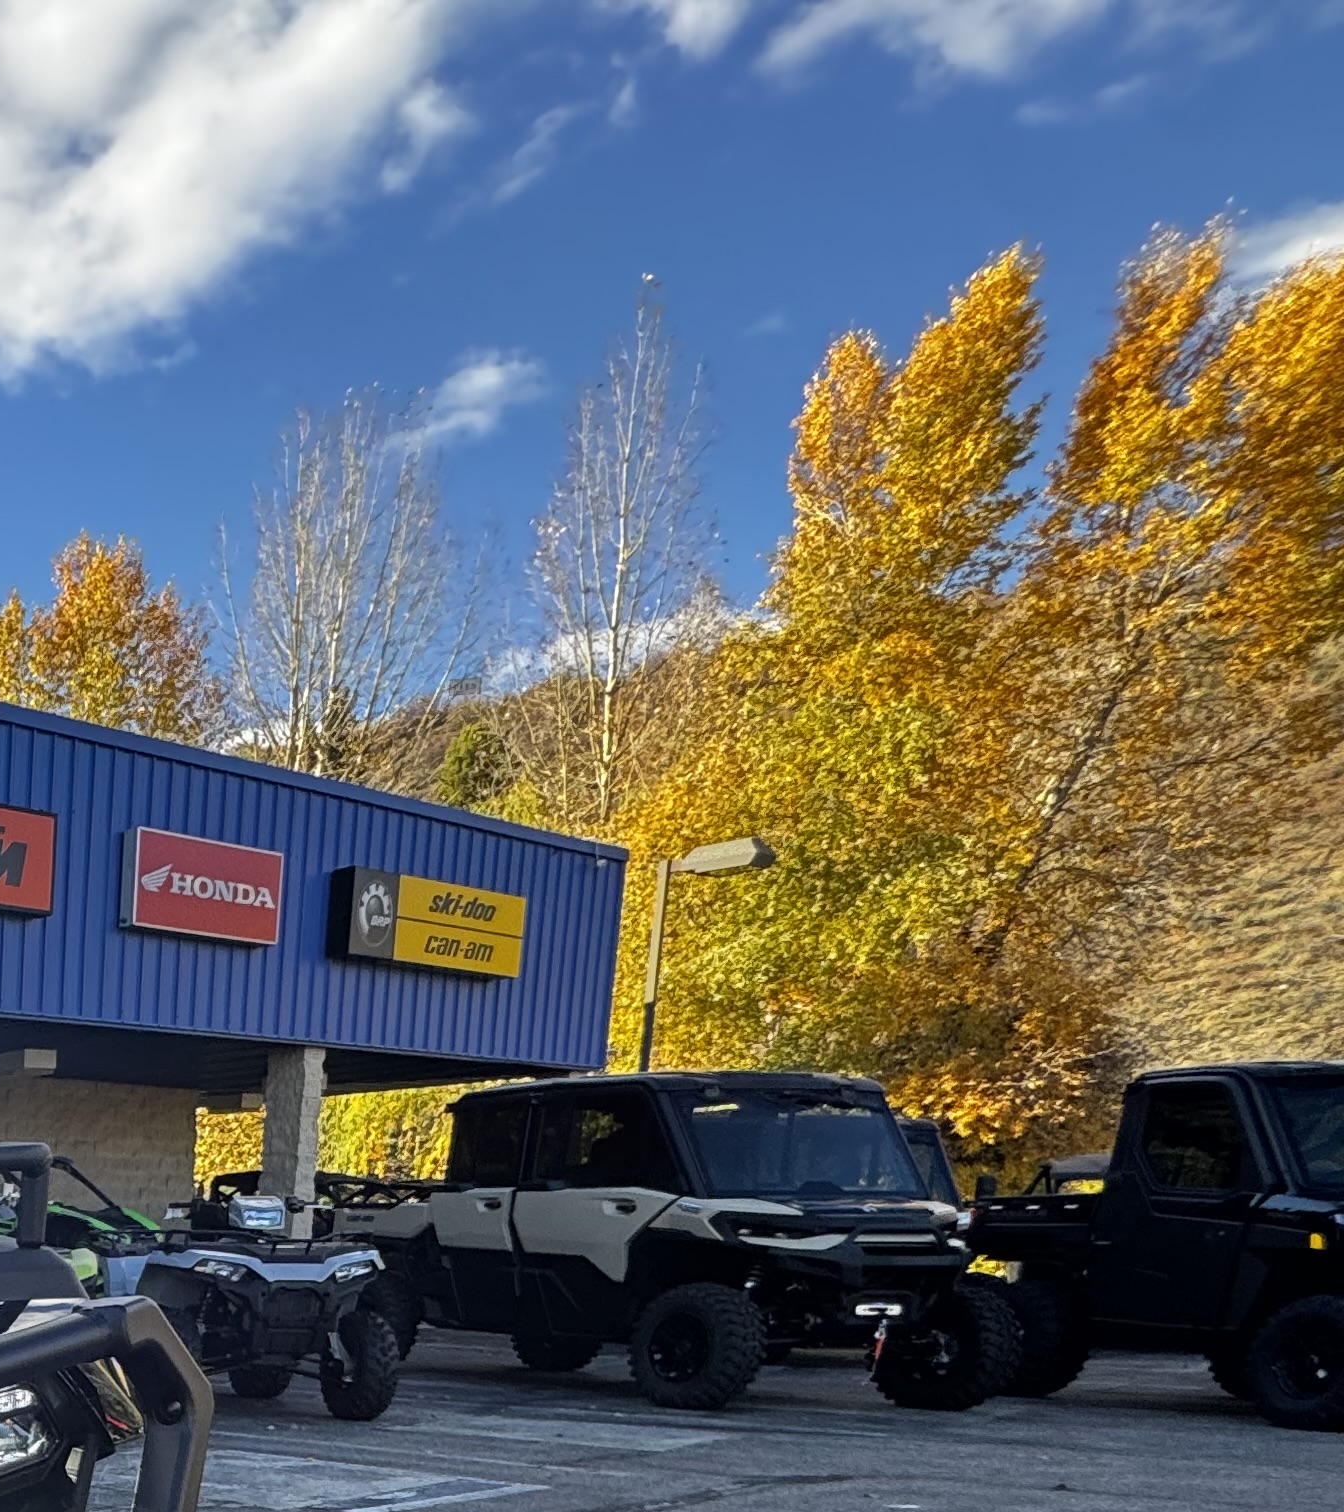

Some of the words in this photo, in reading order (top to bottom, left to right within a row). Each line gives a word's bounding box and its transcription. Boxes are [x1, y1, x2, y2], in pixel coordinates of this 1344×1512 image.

[169, 872, 276, 910] HONDA
[428, 892, 497, 922] ski-doo
[423, 935, 495, 963] can-am
